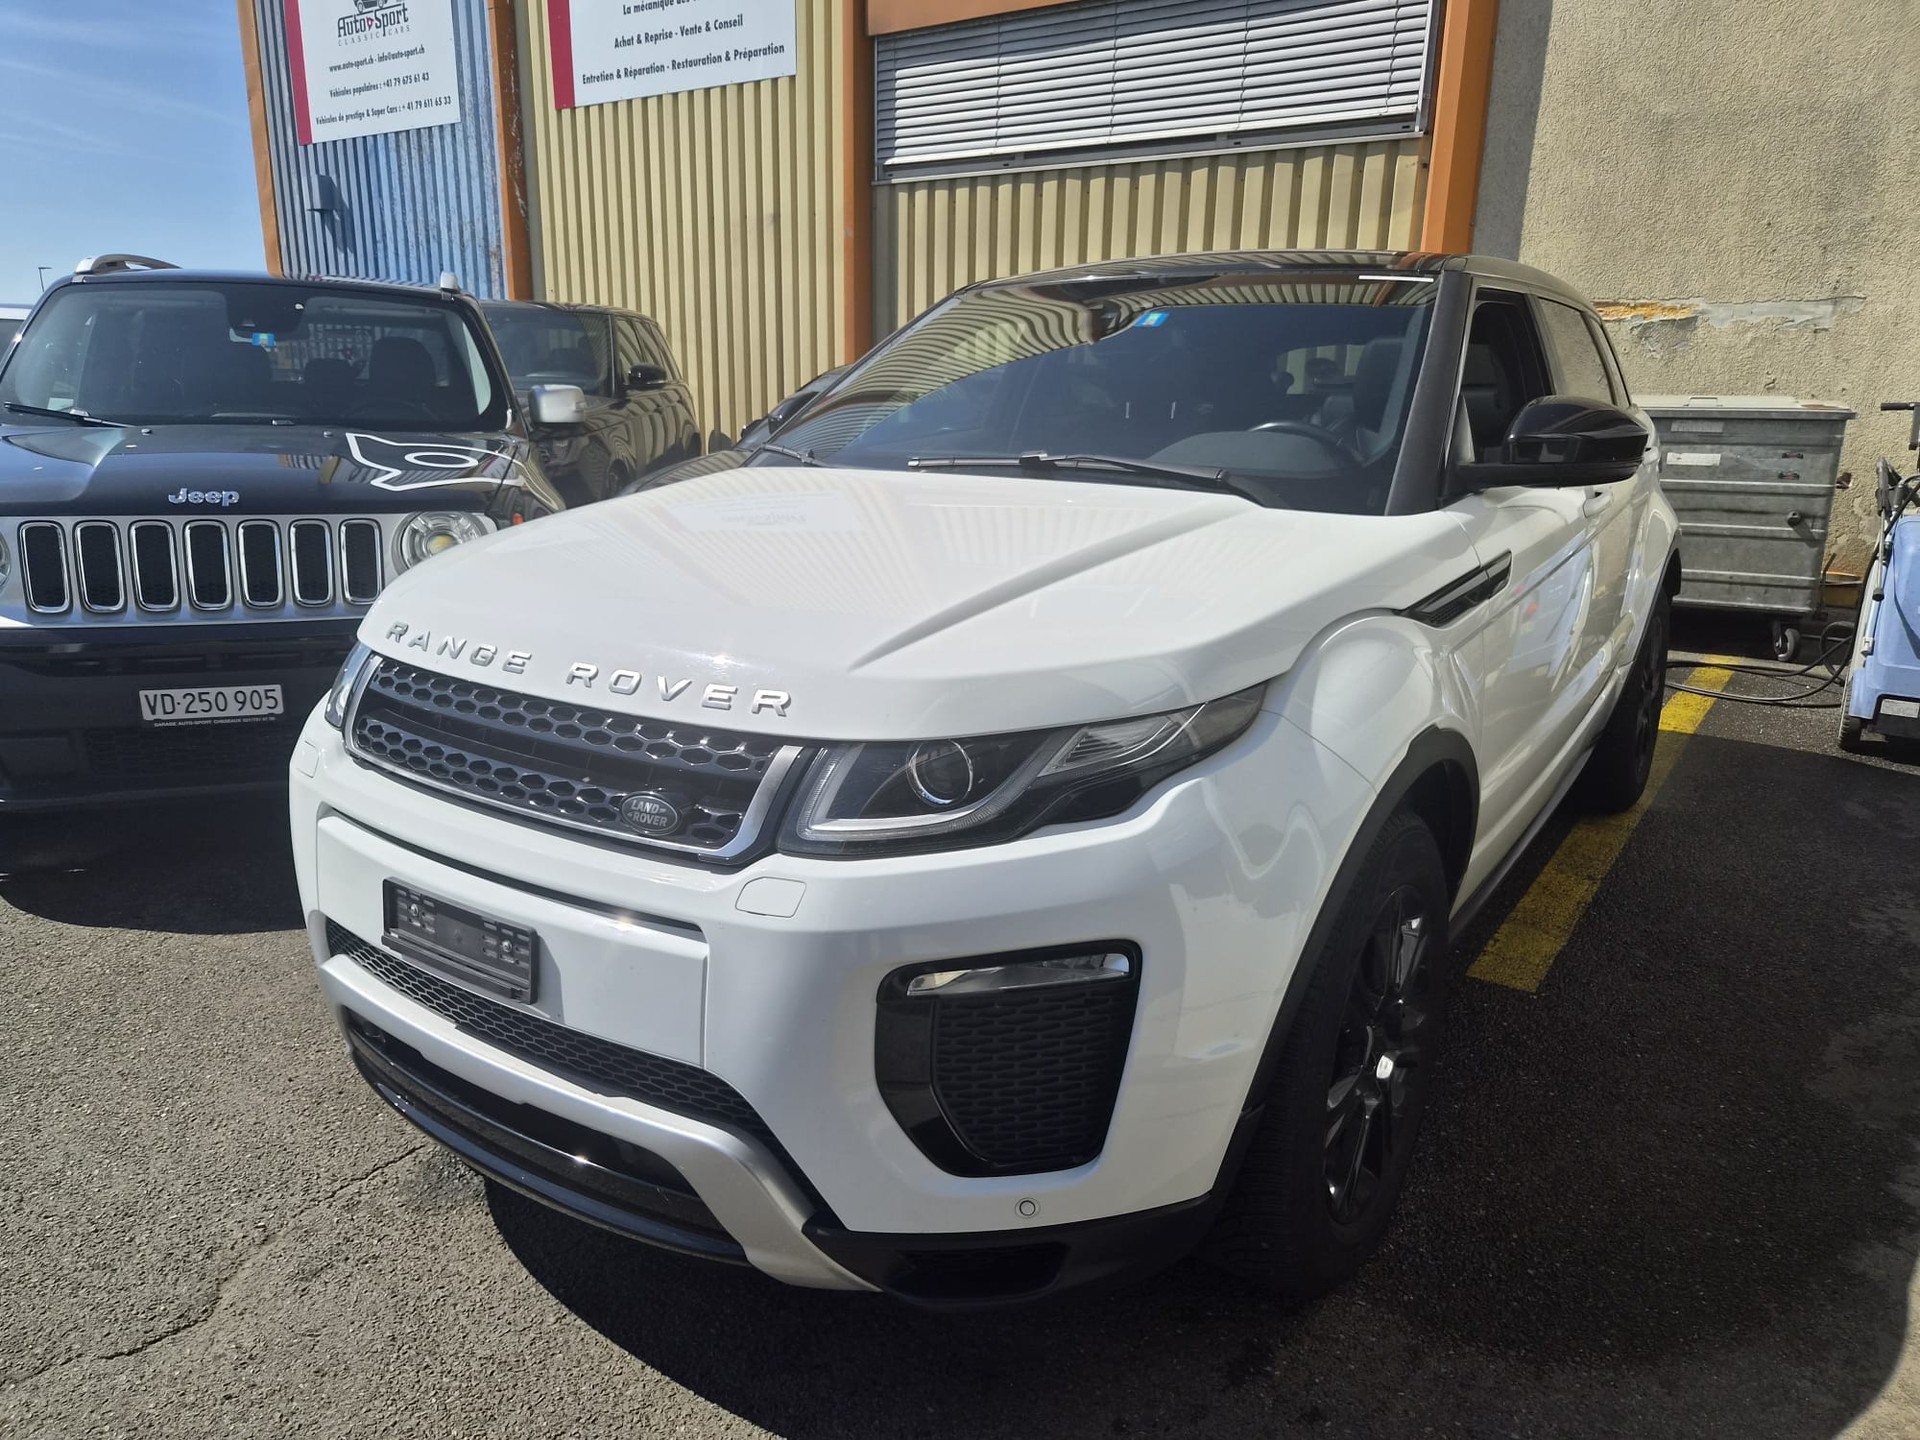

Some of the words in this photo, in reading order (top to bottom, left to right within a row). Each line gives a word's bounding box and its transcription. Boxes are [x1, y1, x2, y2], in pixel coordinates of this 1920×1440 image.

[337, 12, 366, 38] Auto
[374, 2, 409, 37] Sport
[623, 4, 632, 15] La
[338, 32, 380, 46] CLASSIC
[388, 25, 410, 36] CARS
[614, 36, 634, 48] Achat
[637, 34, 642, 44] &
[645, 28, 673, 44] Reprise
[680, 24, 702, 36] Vente
[705, 21, 711, 32] &
[714, 13, 743, 31] Conseil
[329, 55, 374, 72] www.auto-sport.ch
[377, 44, 425, 62] info@auto-sport.ch
[582, 70, 614, 84] Entretien
[616, 69, 622, 79] &
[624, 62, 665, 79] Réparation
[671, 53, 722, 70] Restauration
[724, 51, 731, 61] &
[733, 43, 785, 61] Préparation
[352, 82, 379, 96] populaires
[394, 77, 401, 86] 79
[402, 75, 412, 85] 675
[414, 73, 420, 83] 61
[422, 72, 429, 81] 43
[338, 113, 344, 122] de
[345, 110, 365, 123] prestige
[366, 109, 370, 117] &
[371, 107, 385, 118] Super
[386, 105, 397, 114] Cars
[407, 101, 413, 111] 41
[415, 100, 422, 109] 79
[423, 98, 433, 108] 611
[435, 97, 442, 106] 65
[443, 96, 451, 105] 33
[168, 488, 240, 507] Jeep
[385, 621, 532, 675] RANGE
[566, 662, 791, 717] ROVER
[233, 688, 278, 712] 905
[631, 799, 660, 814] LAND
[632, 811, 668, 827] ROVER
